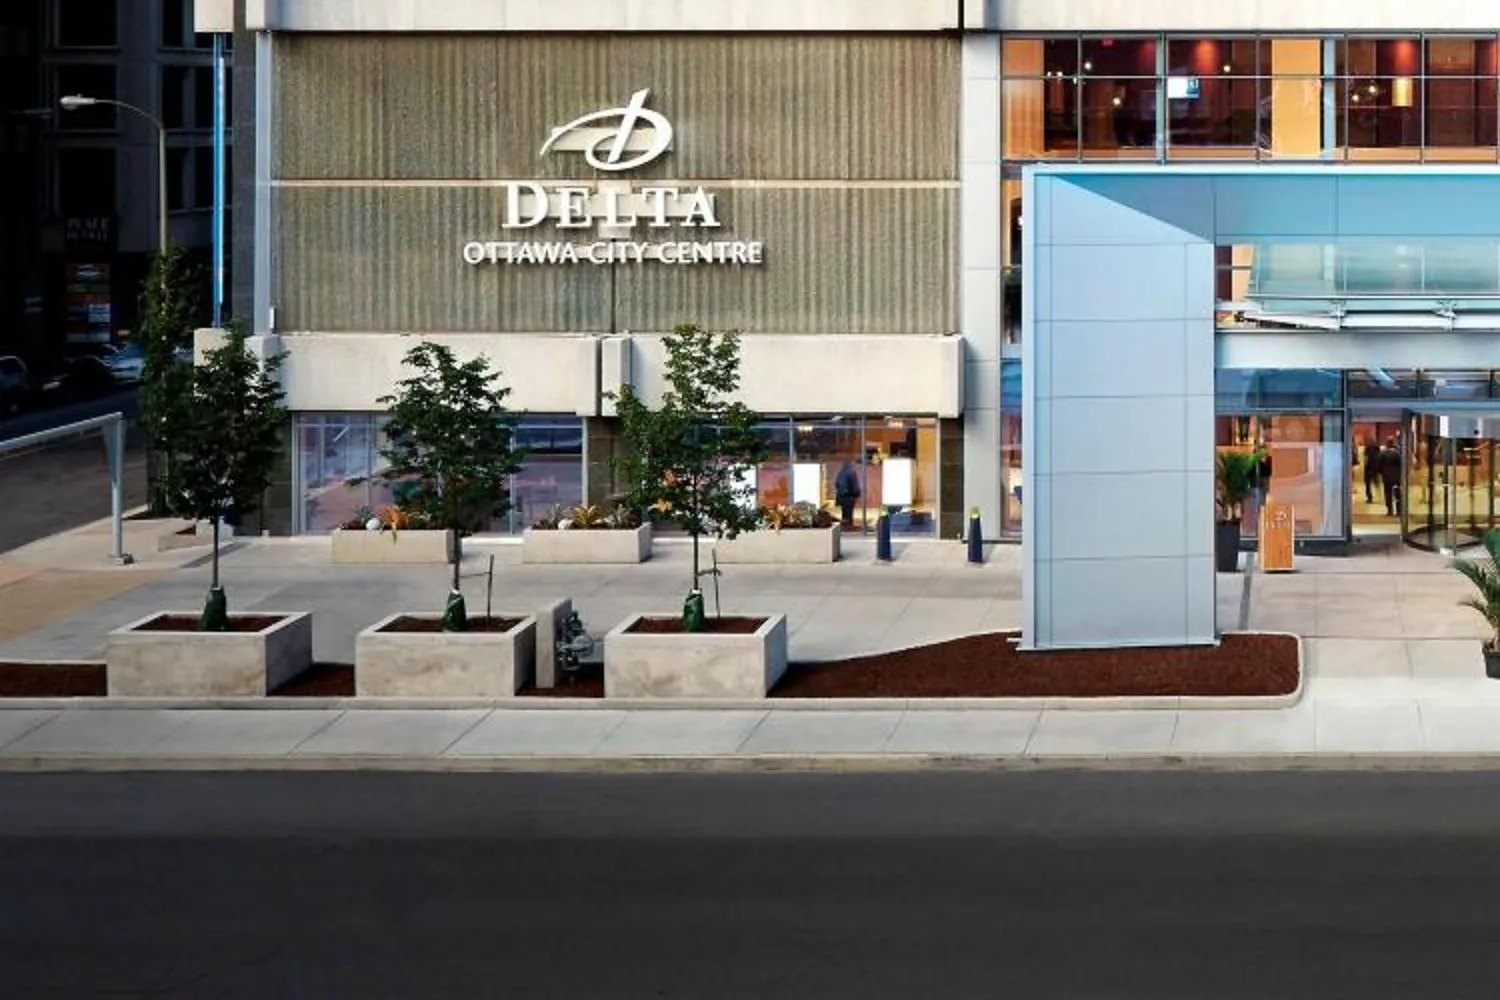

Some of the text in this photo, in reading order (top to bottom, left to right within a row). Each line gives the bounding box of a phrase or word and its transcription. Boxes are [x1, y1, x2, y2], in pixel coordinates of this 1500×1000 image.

[502, 180, 721, 229] DELTA
[463, 241, 763, 265] OTTAWA CITY CENTRE
